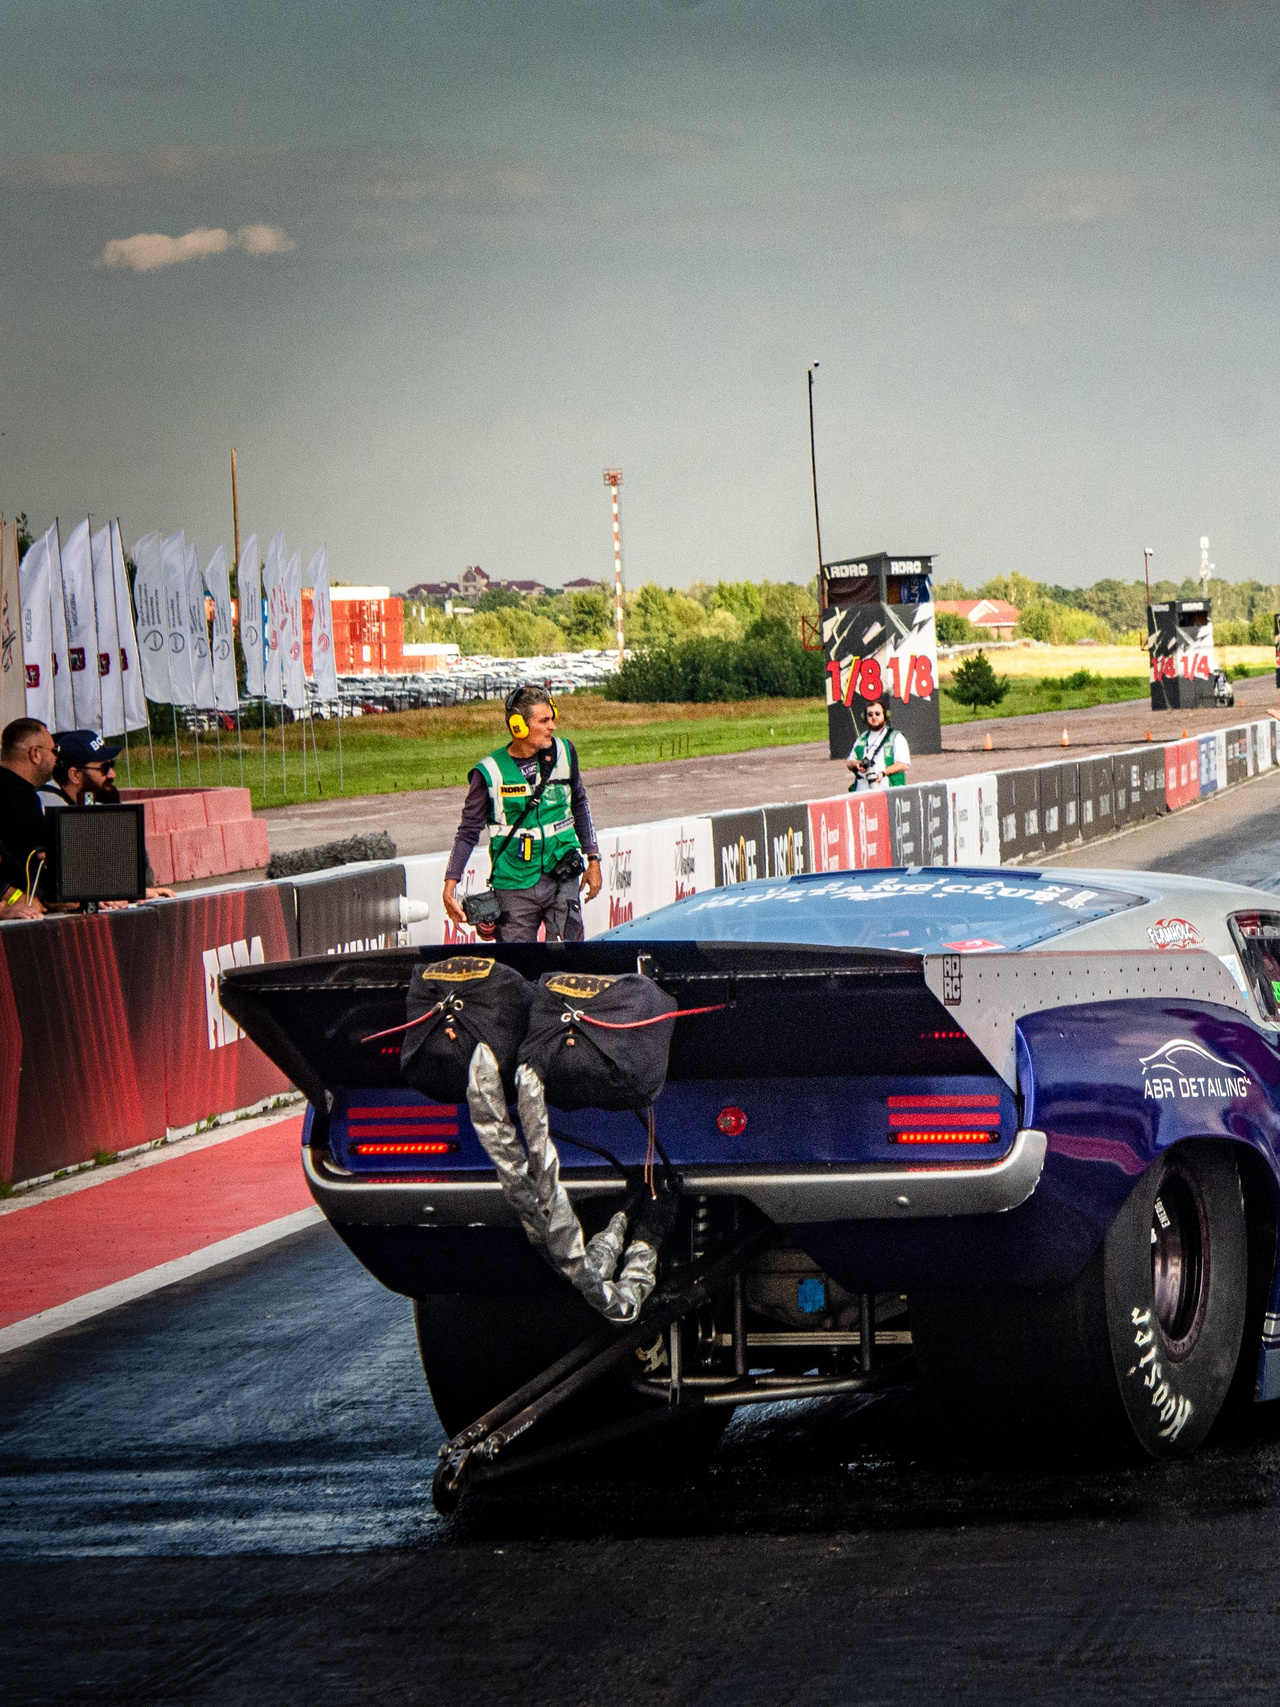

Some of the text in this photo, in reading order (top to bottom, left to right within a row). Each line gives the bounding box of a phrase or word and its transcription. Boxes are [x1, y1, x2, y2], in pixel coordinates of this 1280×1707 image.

[830, 563, 868, 578] RDRC
[891, 560, 922, 574] RDRC
[887, 654, 934, 705] 1/8
[1151, 655, 1175, 682] 1/4
[1180, 652, 1210, 682] 1/4
[825, 658, 883, 708] 1/8
[500, 785, 526, 795] RDRC
[684, 883, 1062, 915] MUSTANG CLUB
[1144, 1078, 1175, 1100] ABR
